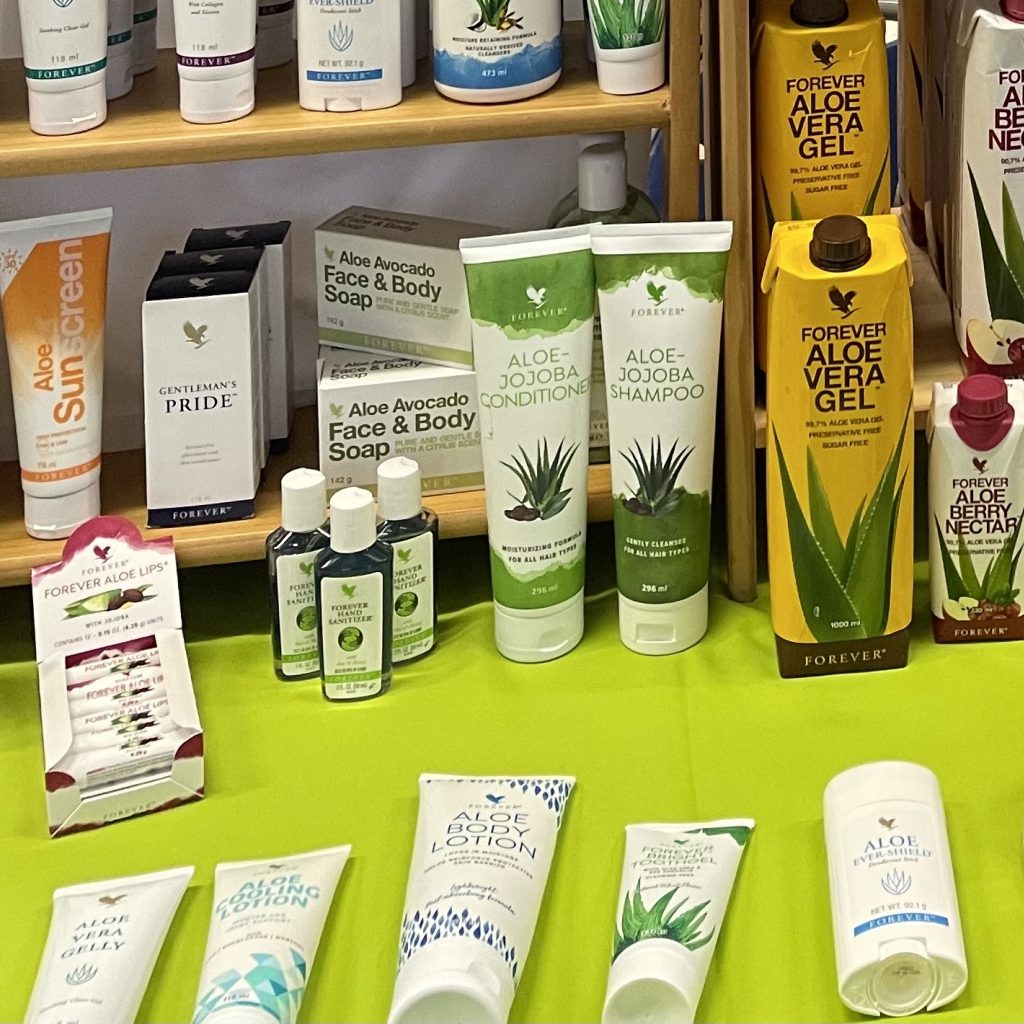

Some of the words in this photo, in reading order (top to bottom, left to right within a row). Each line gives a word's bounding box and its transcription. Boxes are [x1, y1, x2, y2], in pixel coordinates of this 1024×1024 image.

[181, 56, 231, 66] FOREVER
[37, 66, 91, 78] FOREVER
[482, 69, 497, 77] 473
[786, 74, 865, 92] FOREVER
[790, 90, 861, 117] ALOE
[788, 112, 864, 139] VERA
[798, 135, 855, 160] GEL
[805, 186, 829, 194] SUGAR
[339, 250, 371, 267] Aloe
[374, 257, 435, 278] Avocado
[324, 265, 369, 289] Face
[374, 274, 387, 291] &
[392, 276, 441, 303] Body
[324, 285, 373, 311] Soap
[511, 308, 564, 322] FOREVER
[631, 307, 681, 317] FOREVER
[802, 322, 887, 342] FOREVER
[508, 348, 570, 369] ALOE-
[625, 348, 686, 364] ALOE-
[805, 340, 883, 366] ALOE
[33, 344, 53, 391] Aloe
[618, 366, 694, 384] JOJOBA
[499, 366, 579, 391] JOJOBA
[803, 364, 886, 390] VERA
[159, 380, 237, 395] GENTLEMAN'S
[610, 384, 704, 402] SHAMPOO
[166, 393, 233, 413] PRIDE
[349, 403, 389, 418] Aloe
[392, 393, 469, 413] Avocado
[814, 388, 875, 413] GEL
[329, 422, 386, 441] Face
[392, 416, 409, 434] &
[415, 409, 476, 431] Body
[808, 428, 861, 439] PRESERVATIVE
[863, 426, 882, 435] FREE
[329, 442, 390, 462] Soap
[822, 441, 847, 450] SUGAR
[848, 439, 869, 447] FREE
[952, 477, 1009, 489] FOREVER
[955, 488, 1006, 504] ALOE
[172, 507, 227, 519] FOREVER
[950, 503, 1012, 519] BERRY
[945, 517, 1017, 535] NECTAR
[626, 537, 649, 547] GENTLY
[44, 579, 101, 599] FOREVER
[105, 571, 136, 585] ALOE
[140, 564, 164, 576] LIPS
[641, 583, 657, 593] 296
[658, 583, 668, 593] ml
[331, 602, 368, 611] FOREVER
[328, 616, 372, 625] SANITIZER
[830, 621, 849, 629] 1000
[954, 627, 1005, 637] FOREVER
[804, 649, 882, 667] FOREVER
[452, 811, 529, 825] ALOE
[447, 824, 531, 838] BODY
[431, 835, 536, 860] LOTION
[864, 835, 919, 853] ALOE
[631, 857, 718, 869] TOOTHGEL
[854, 849, 931, 867] EVER-SHIELD
[238, 874, 303, 892] ALOE
[215, 882, 321, 914] COOLING
[220, 894, 309, 921] LOTION
[74, 914, 129, 930] ALOE
[869, 914, 931, 929] FOREVER
[71, 928, 123, 943] VERA
[60, 940, 127, 960] GELLY
